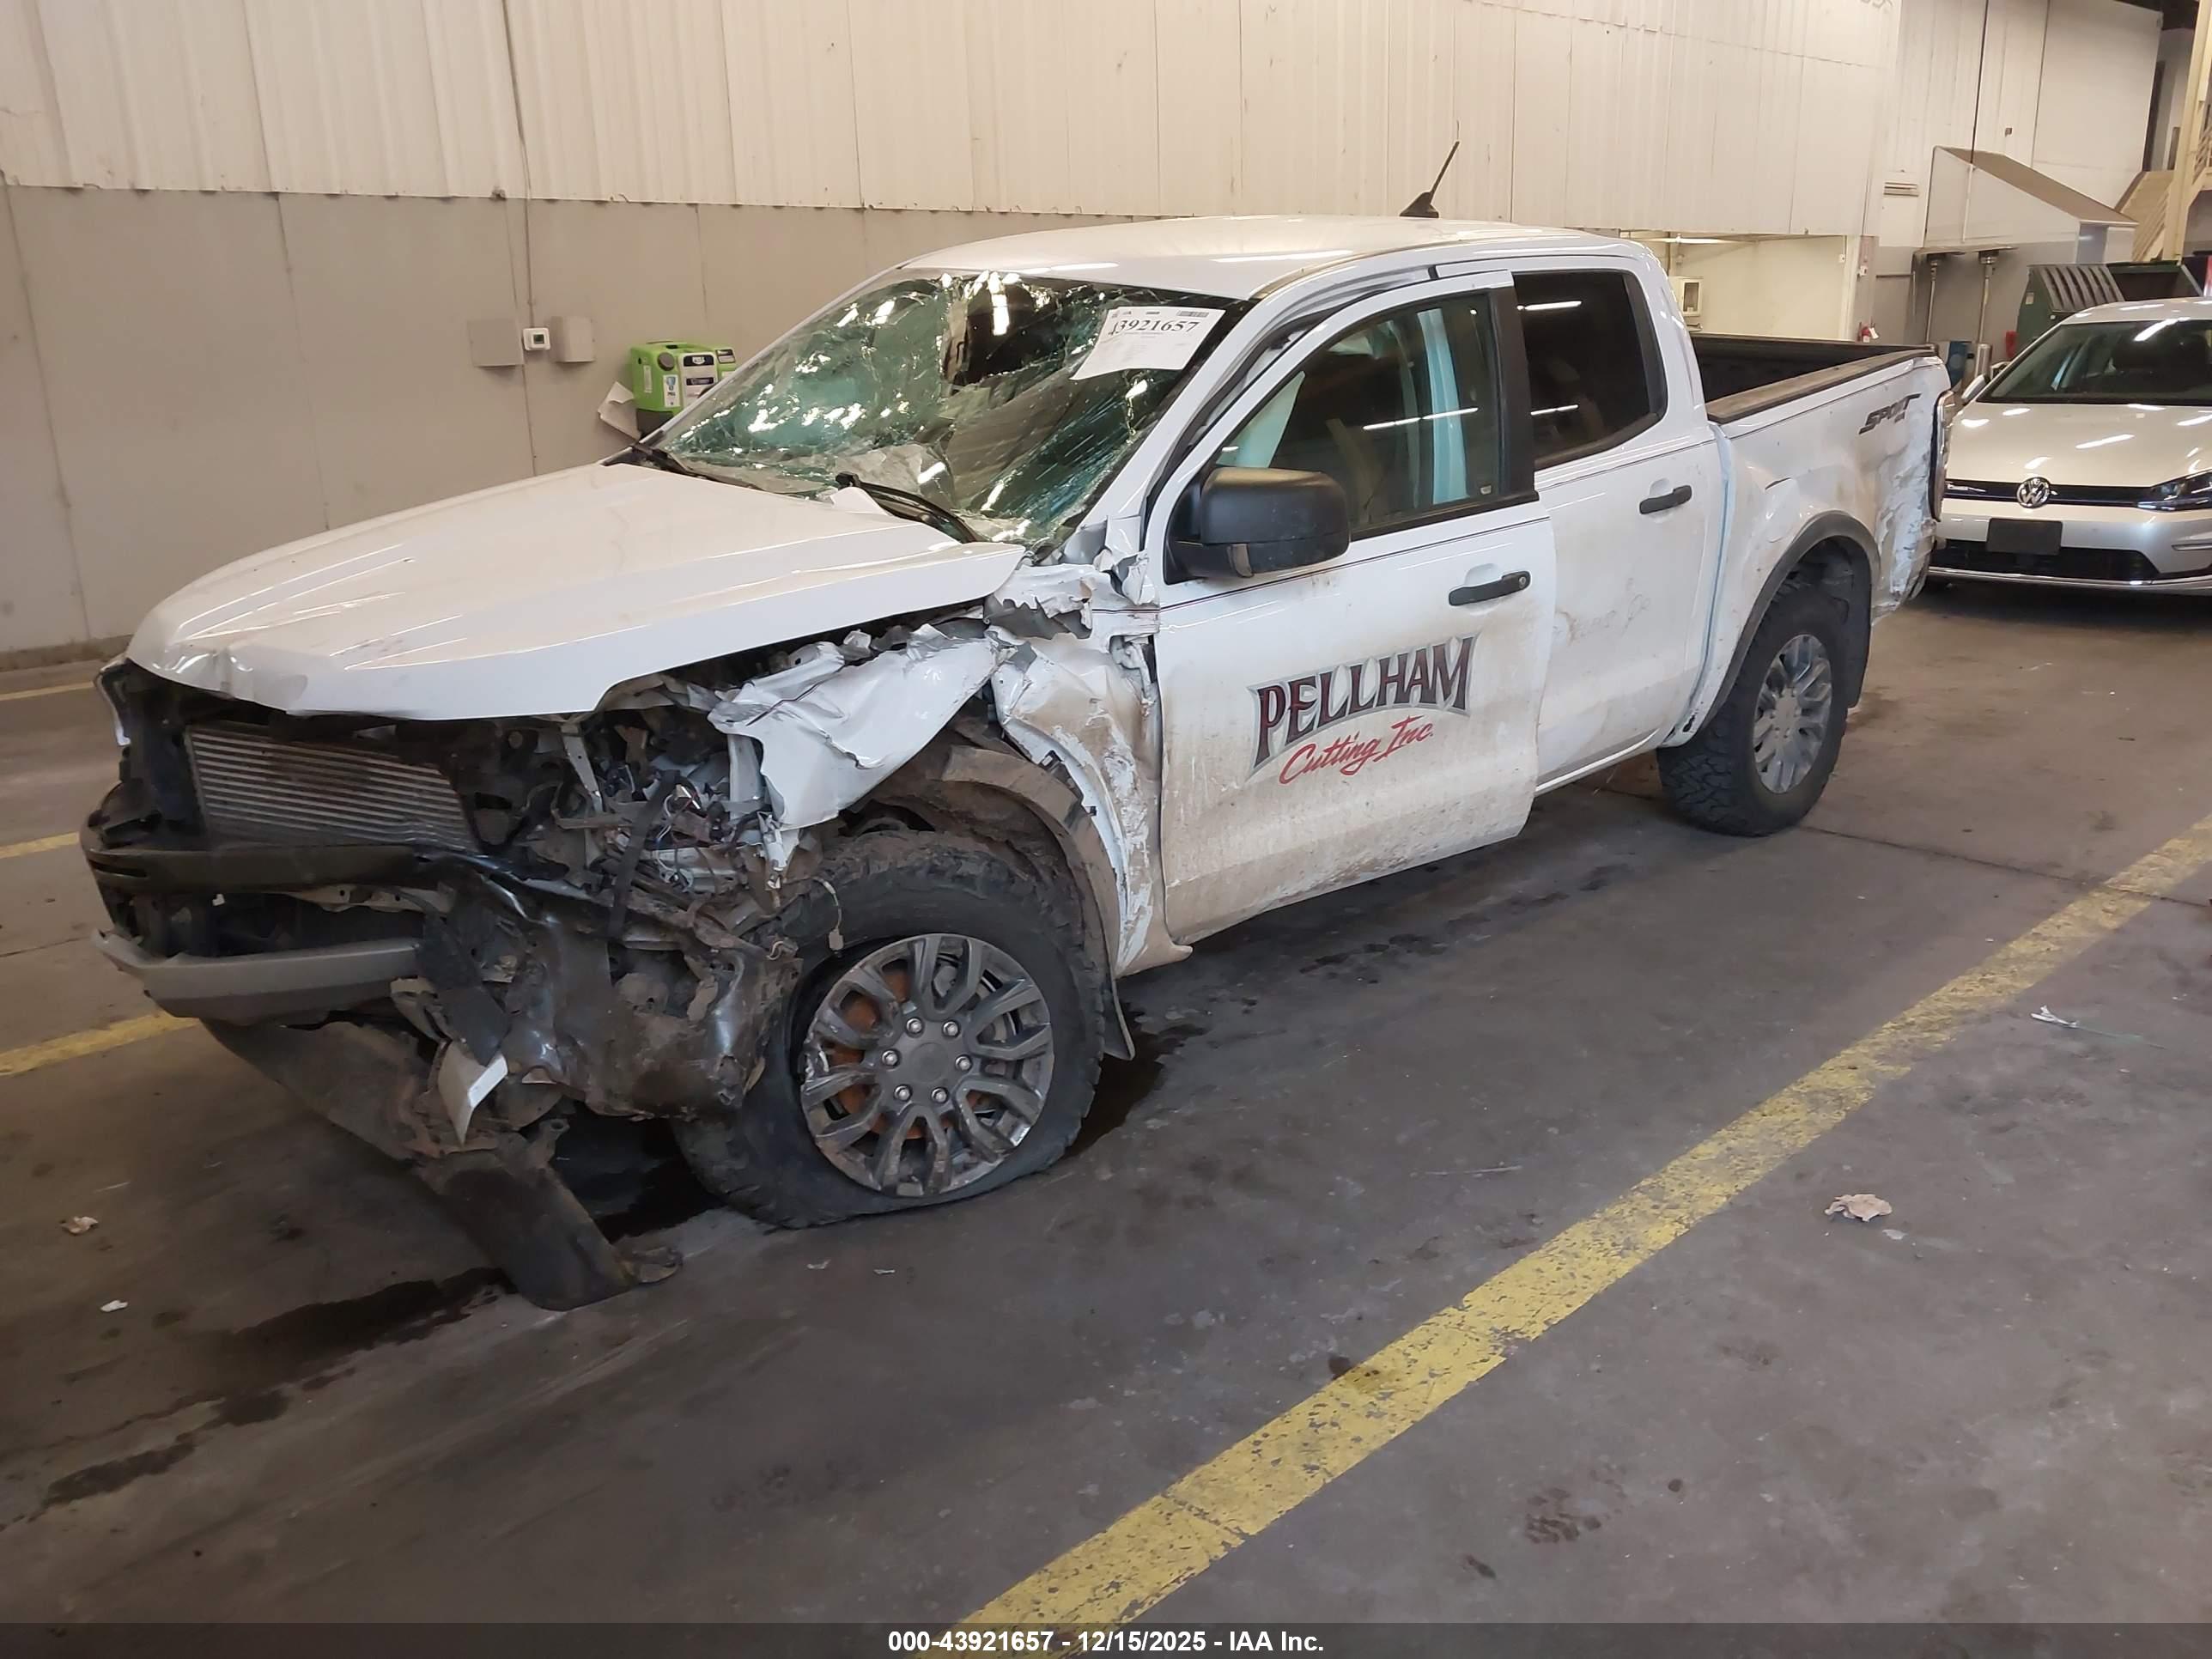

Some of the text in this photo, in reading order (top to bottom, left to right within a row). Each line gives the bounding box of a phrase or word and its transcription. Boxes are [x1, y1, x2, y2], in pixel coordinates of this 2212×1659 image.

[1252, 635, 1476, 769] PELLHAM
[1279, 714, 1435, 785] Cutting Inc.
